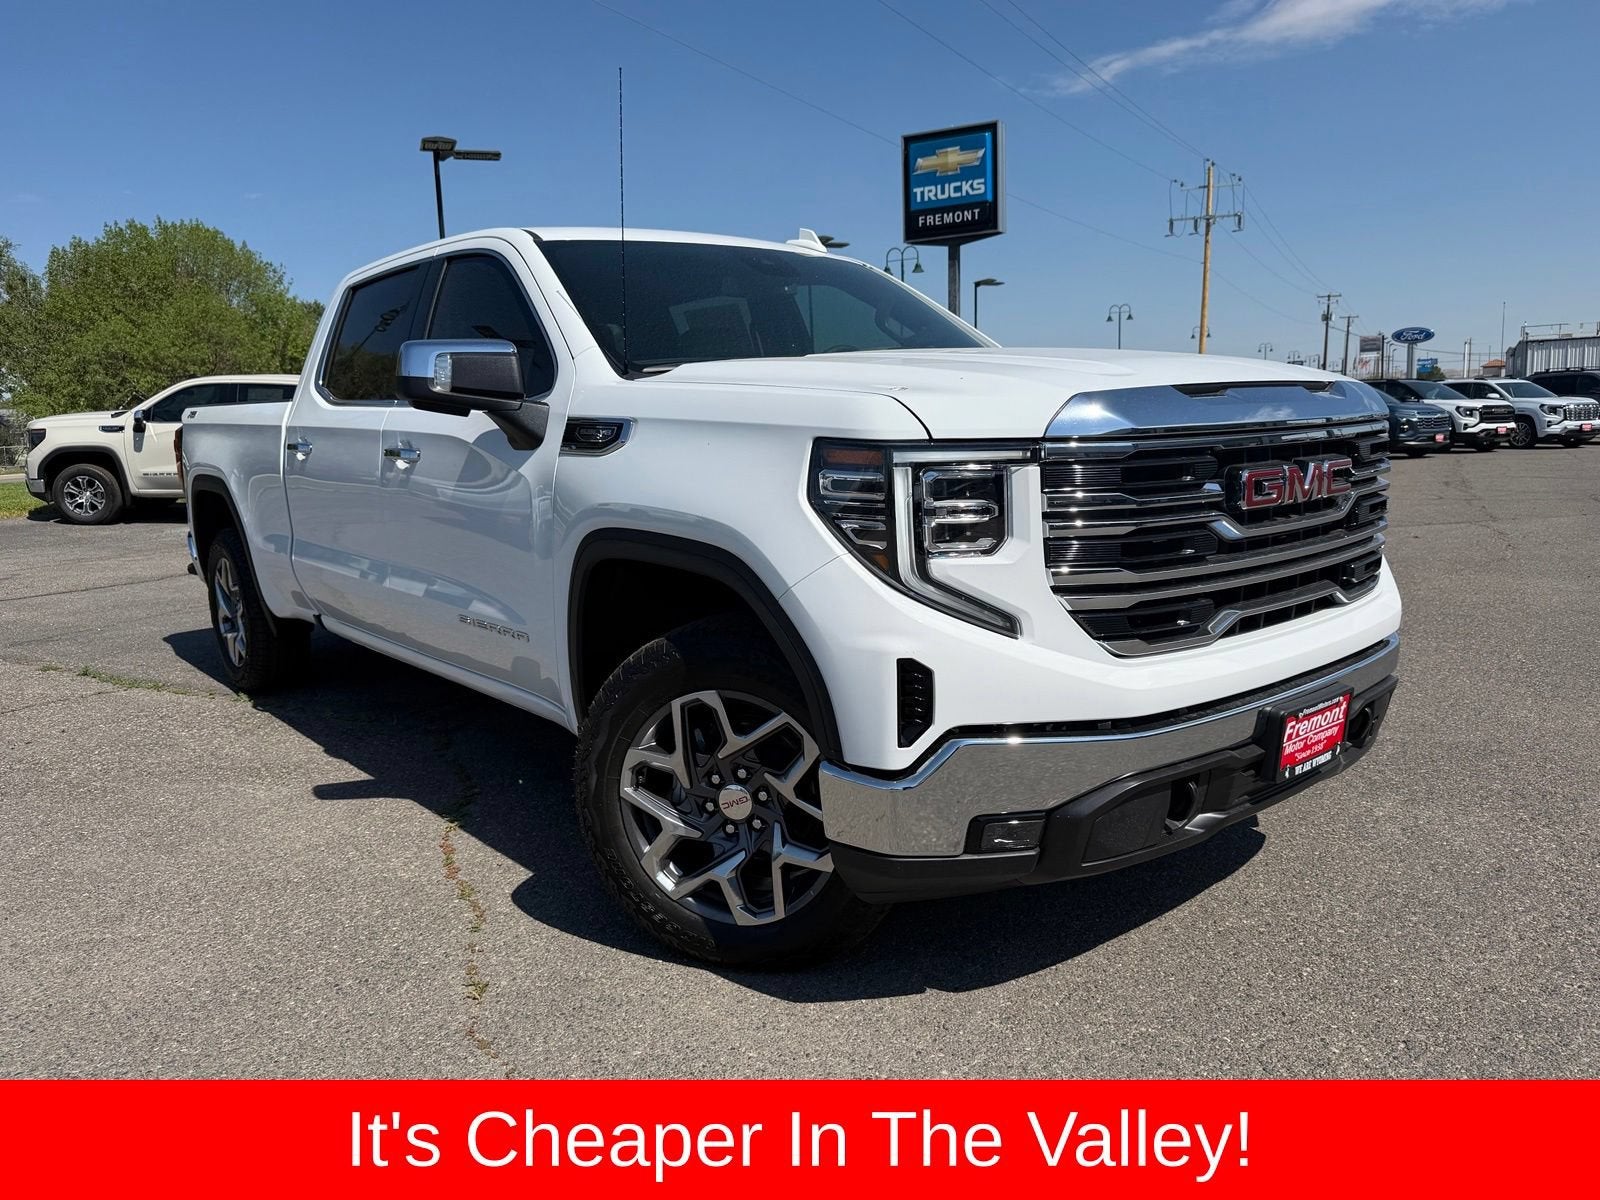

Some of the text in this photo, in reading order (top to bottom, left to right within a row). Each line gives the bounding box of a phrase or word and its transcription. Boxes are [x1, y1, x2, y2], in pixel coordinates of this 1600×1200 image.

[913, 178, 985, 203] TRUCKS
[918, 208, 980, 227] FREMONT
[1400, 330, 1426, 341] Ford
[1239, 458, 1353, 510] GMC
[458, 613, 530, 643] SIERRA
[1283, 700, 1347, 743] Fremont
[1284, 725, 1340, 756] Motor Company
[721, 796, 749, 810] GMC
